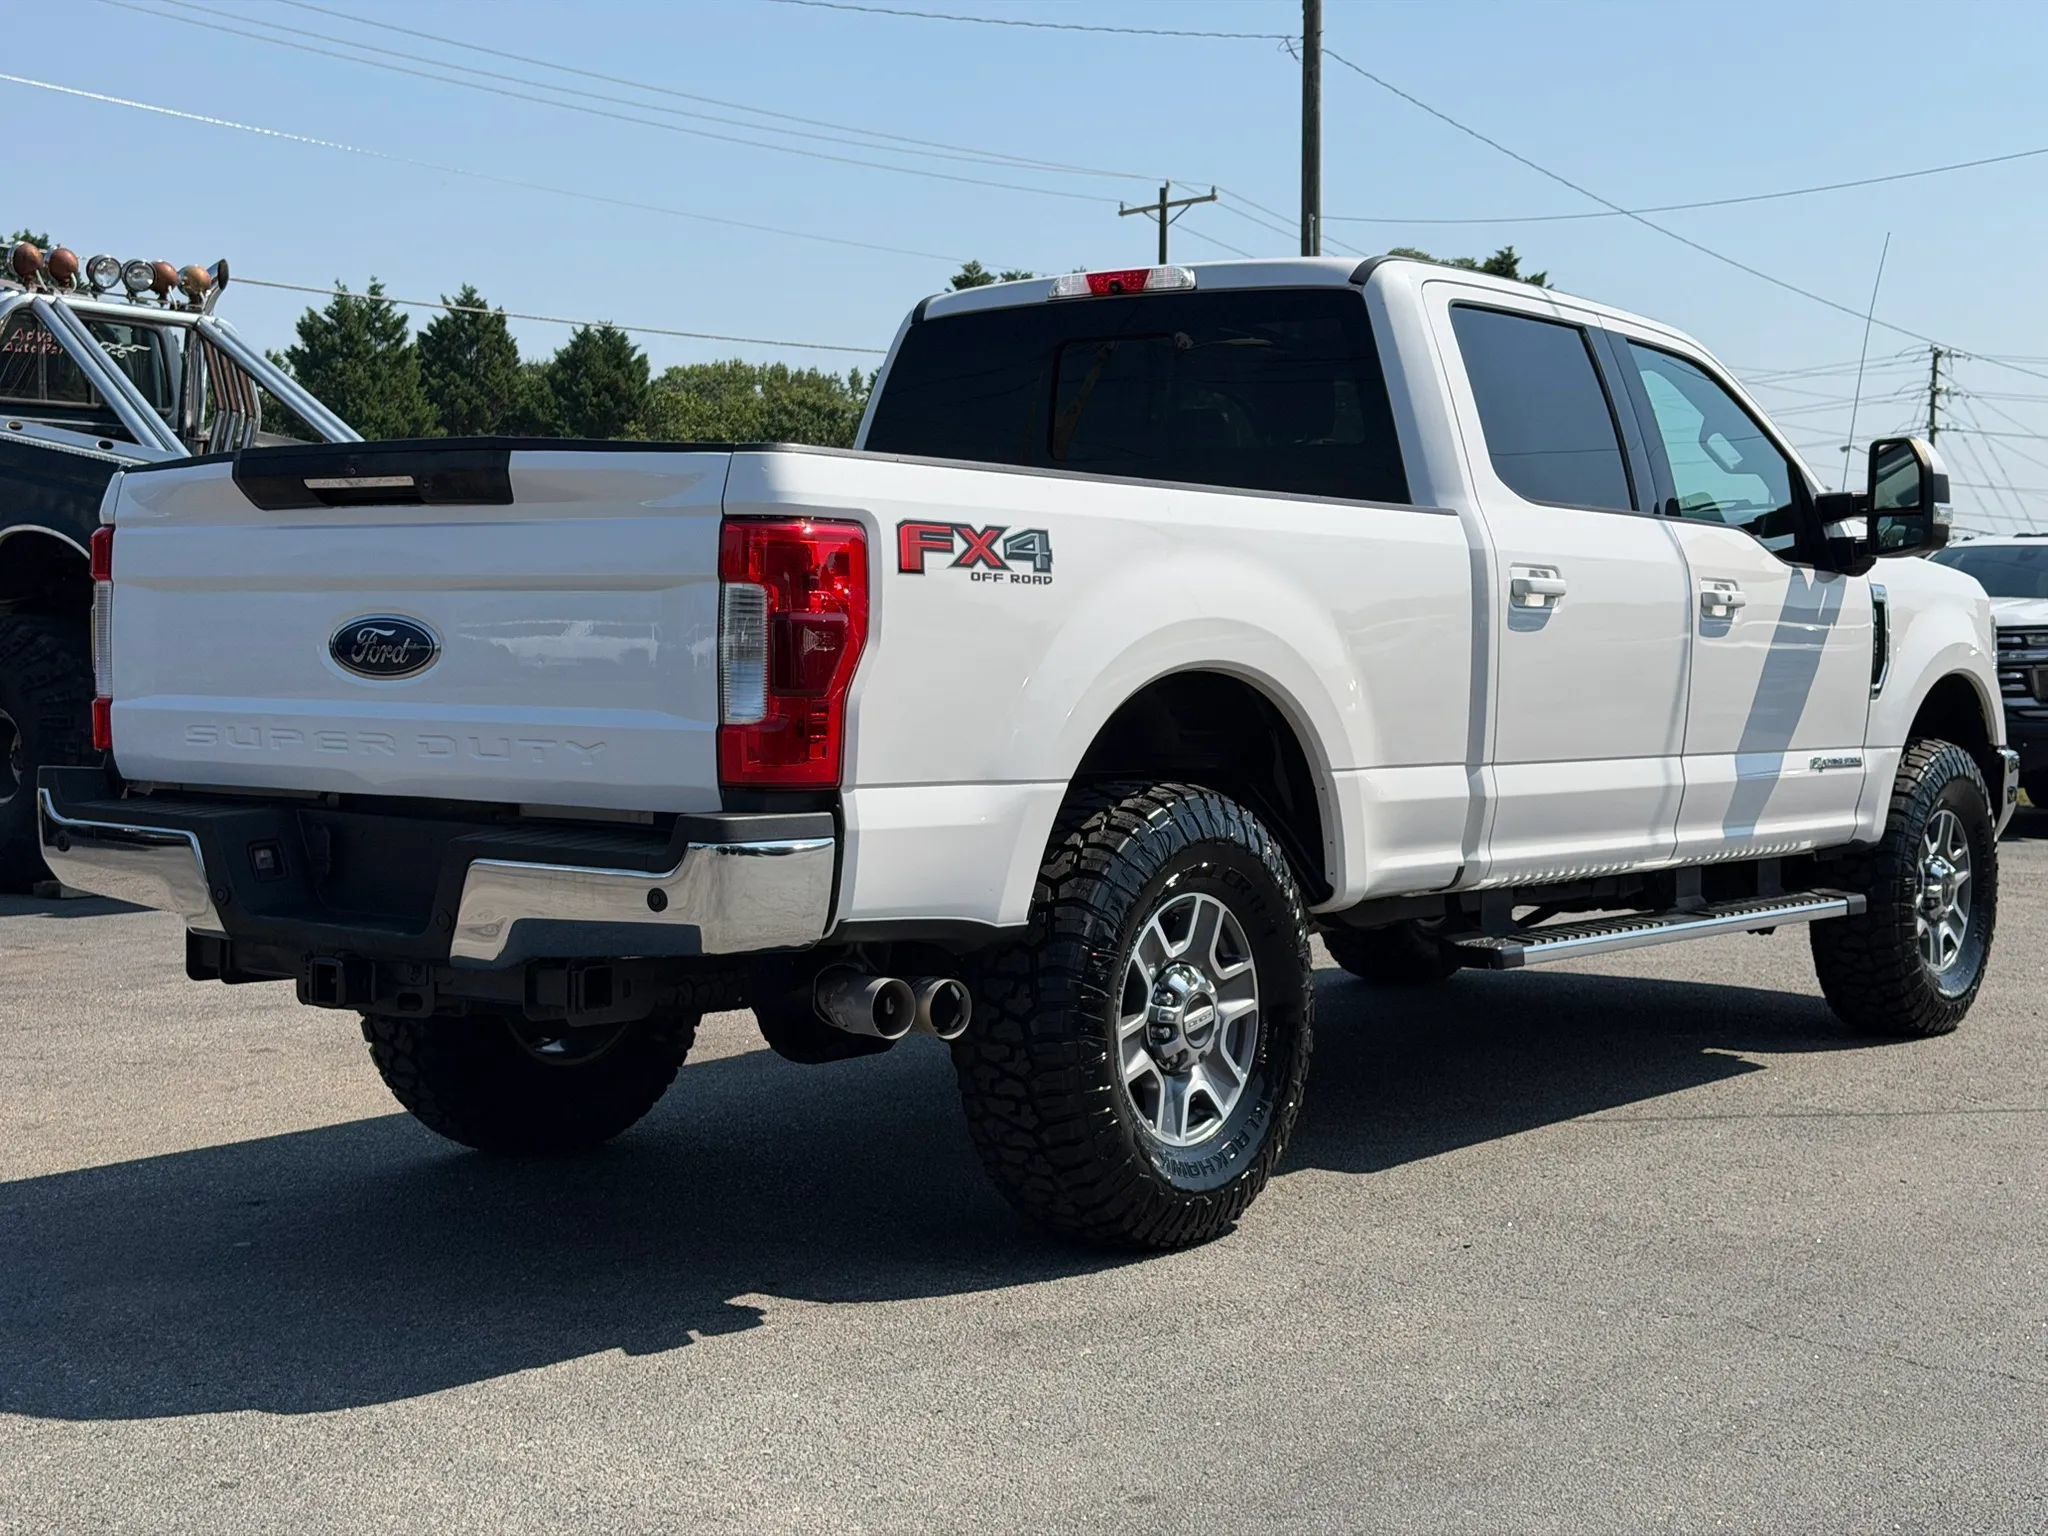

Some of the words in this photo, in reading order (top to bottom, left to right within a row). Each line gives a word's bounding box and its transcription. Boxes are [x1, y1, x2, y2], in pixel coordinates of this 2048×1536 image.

[896, 519, 1053, 576] FX4
[970, 572, 1004, 583] OFF
[1010, 574, 1053, 586] ROAD
[351, 627, 412, 665] Ford
[185, 724, 396, 758] SUPER
[416, 734, 607, 768] DUTY
[1160, 1099, 1268, 1178] BLACKHAWK
